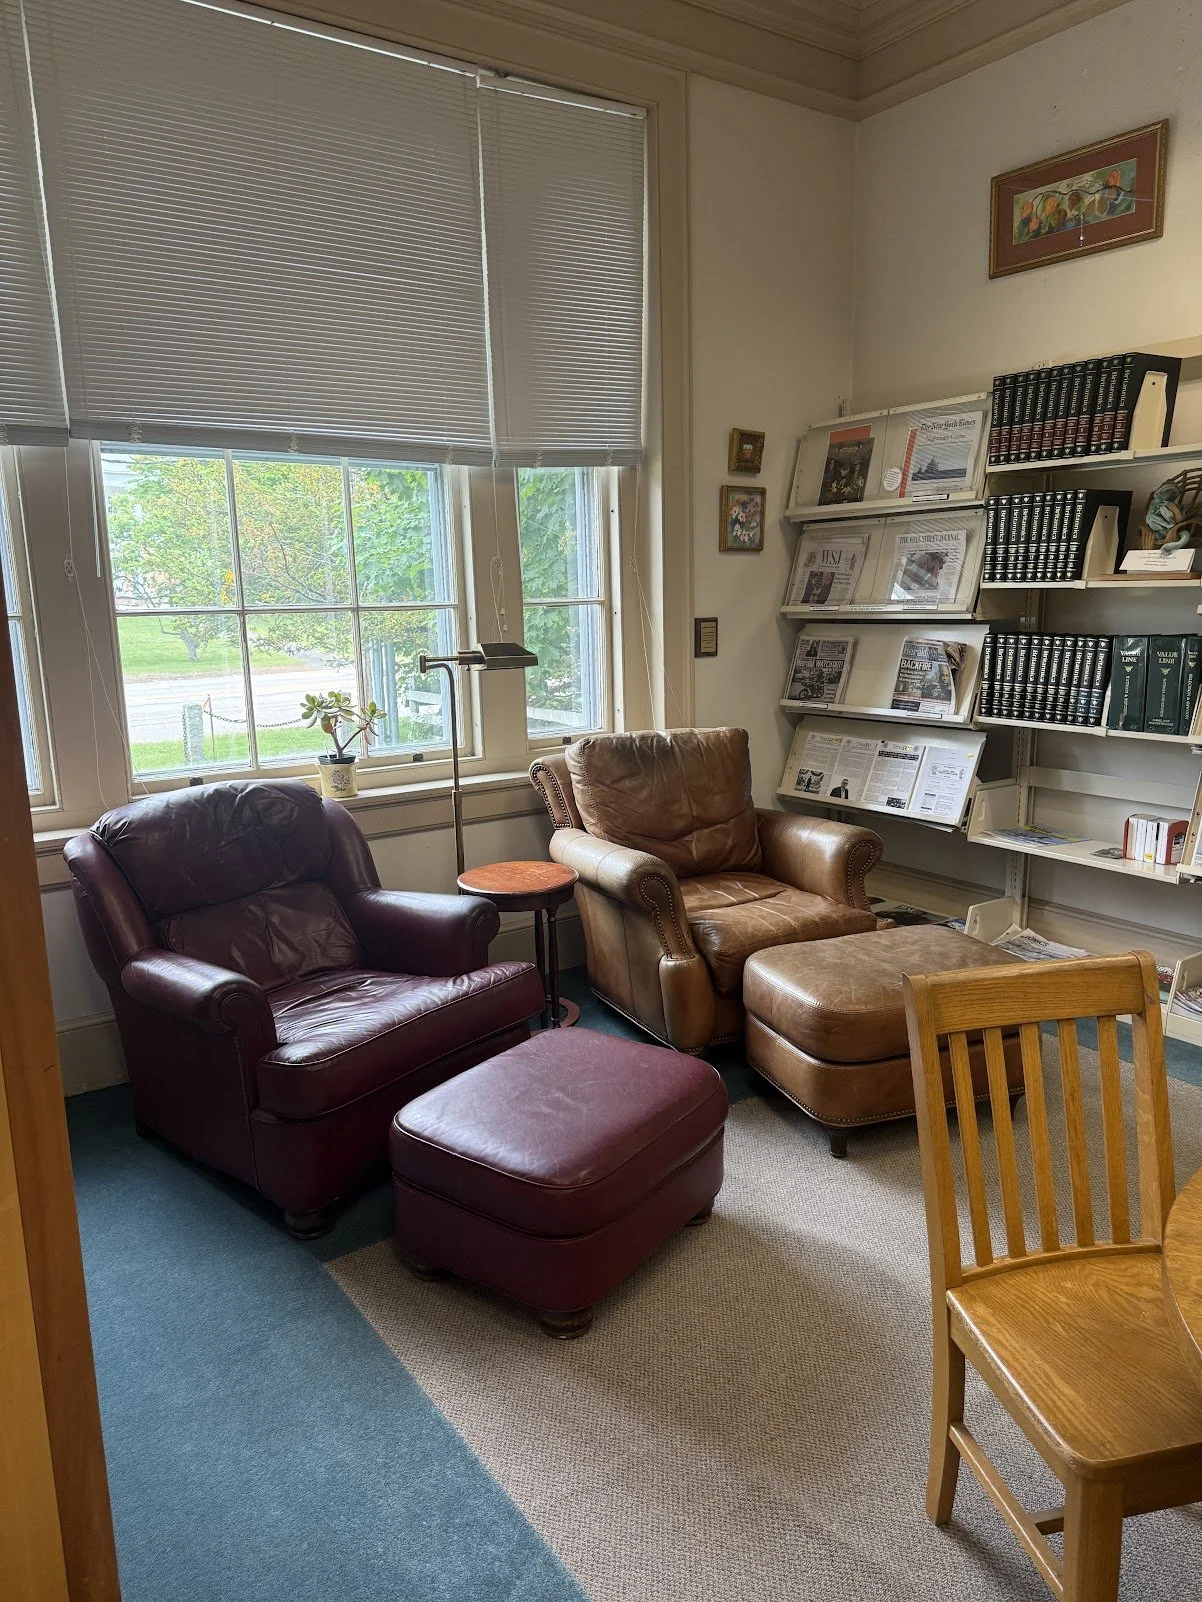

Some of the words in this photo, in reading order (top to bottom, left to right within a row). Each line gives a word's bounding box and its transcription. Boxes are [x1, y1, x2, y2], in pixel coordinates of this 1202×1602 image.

[958, 418, 976, 427] Times
[821, 550, 842, 565] WSJ
[903, 644, 926, 657] Herald
[901, 660, 932, 670] BACKFIRE
